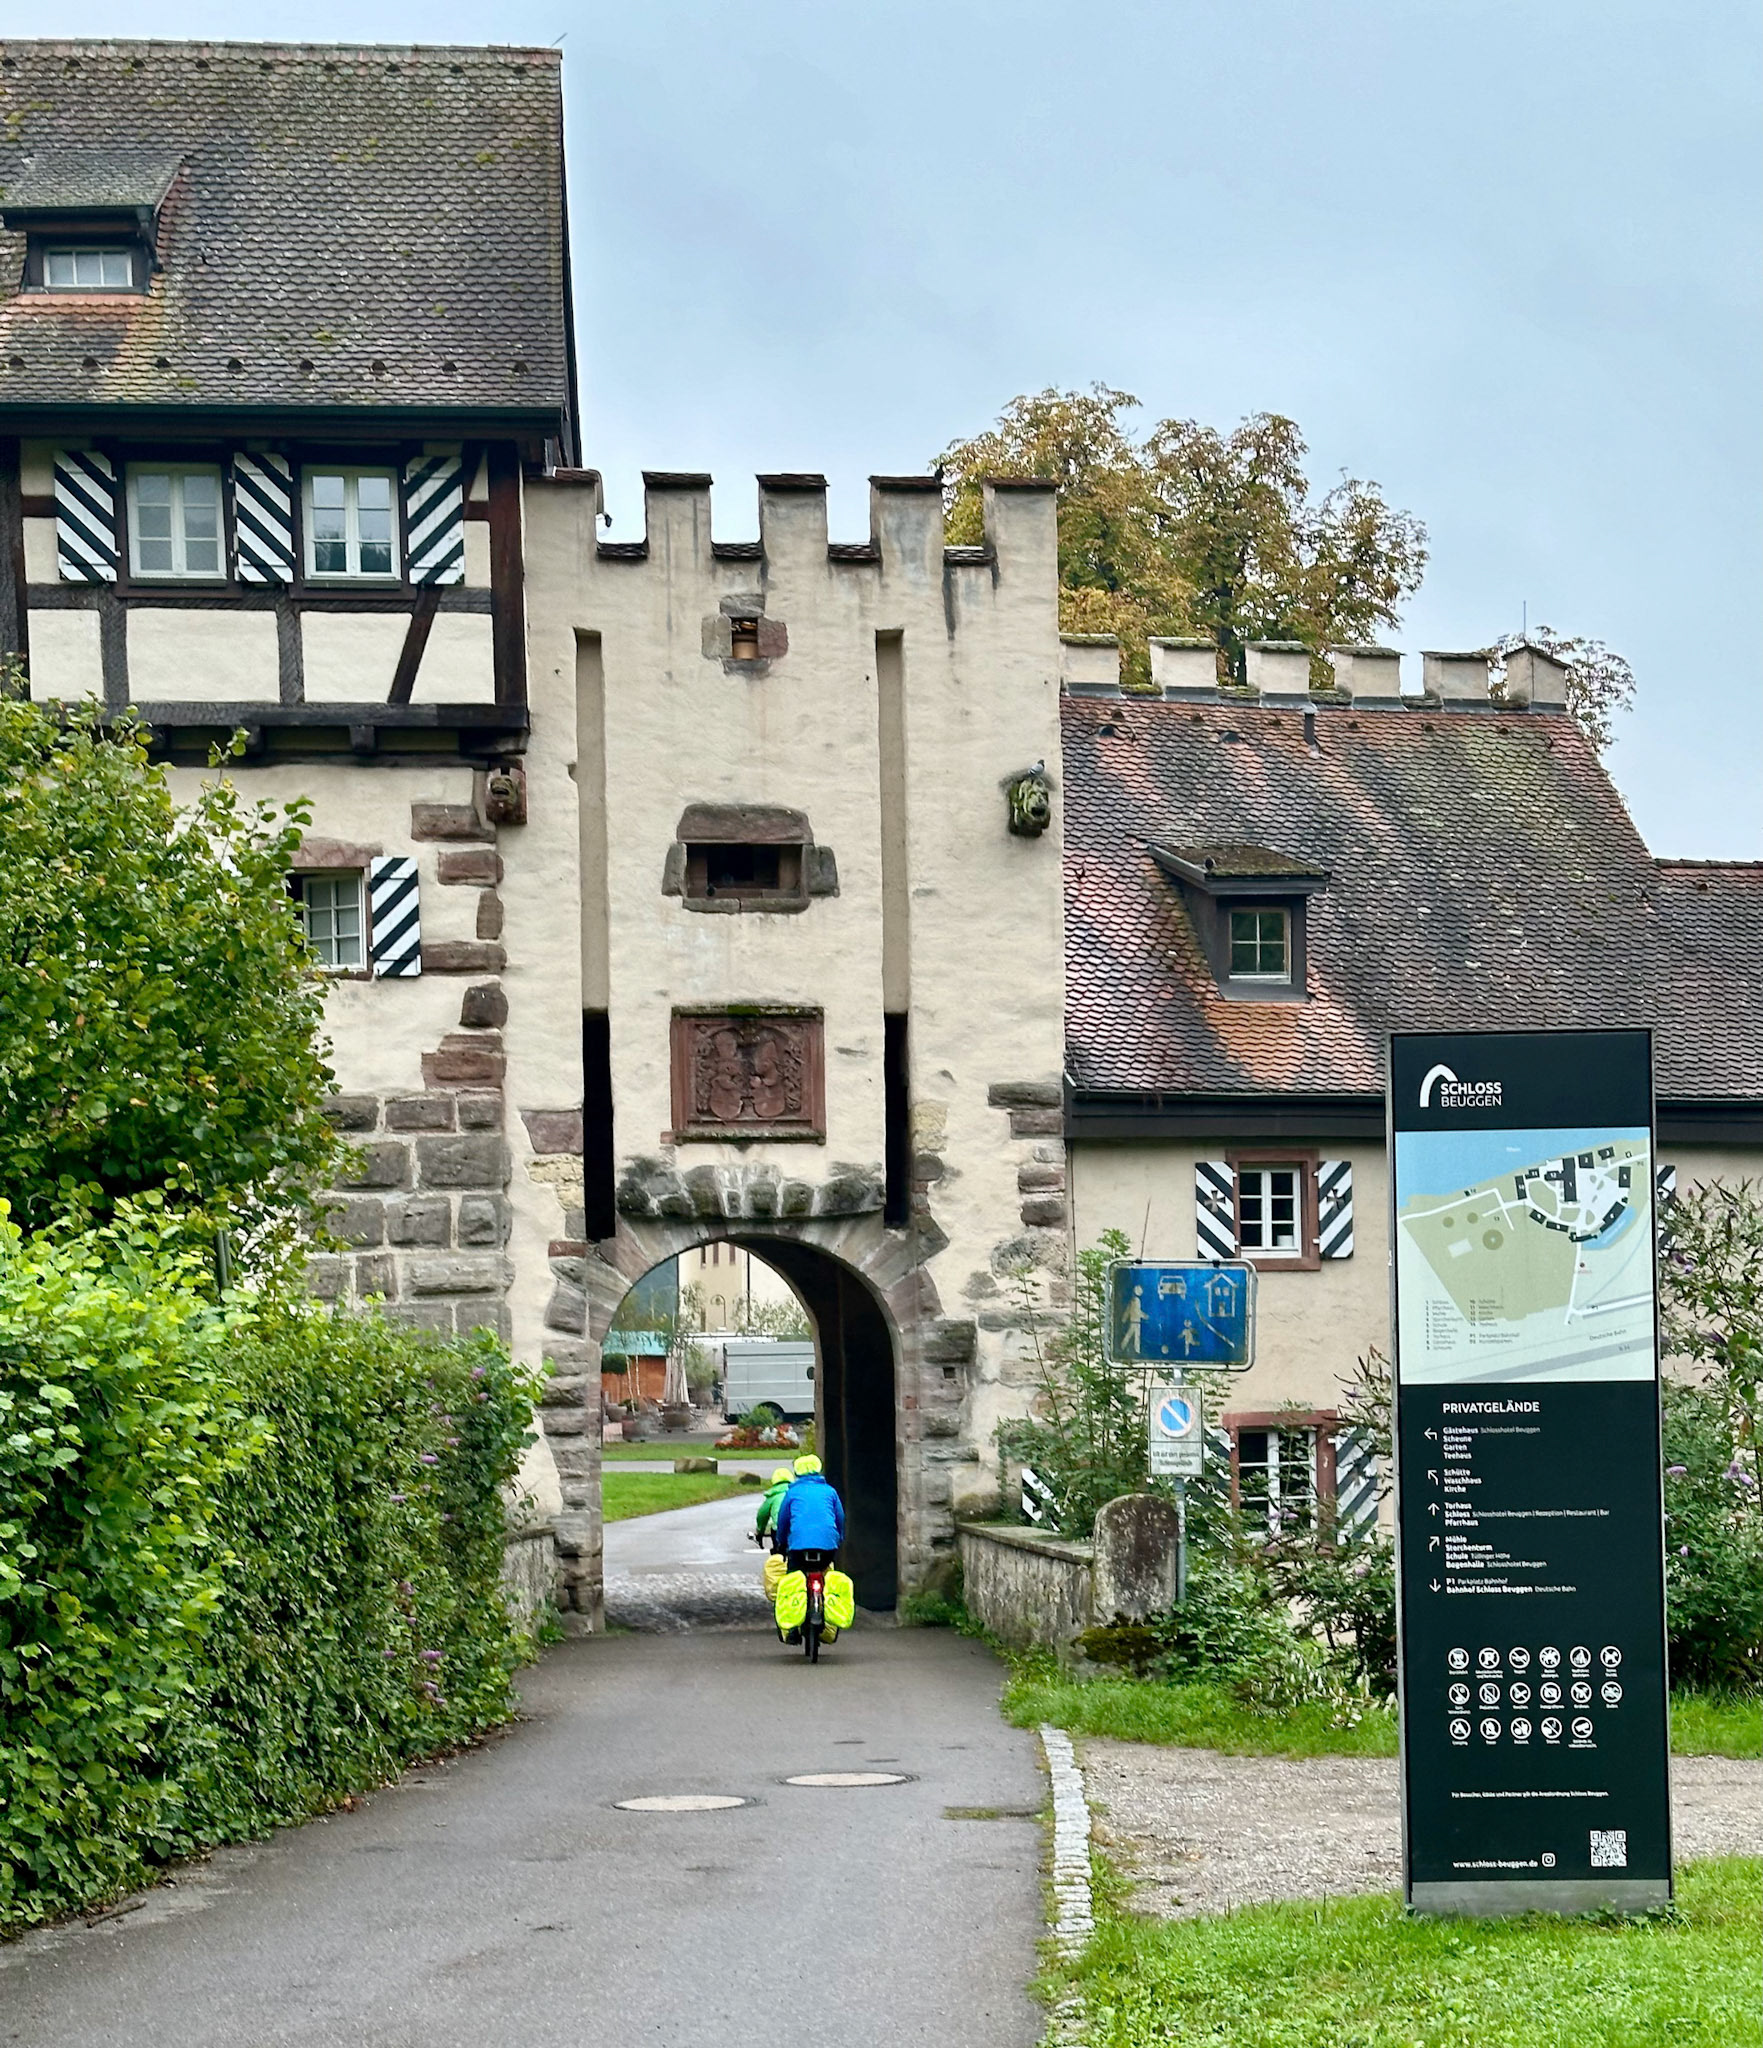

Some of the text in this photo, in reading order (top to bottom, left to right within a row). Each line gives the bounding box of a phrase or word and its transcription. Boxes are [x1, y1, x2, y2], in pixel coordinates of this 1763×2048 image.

[1440, 1082, 1502, 1095] SCHLOSS
[1441, 1095, 1502, 1107] BEUGGEN
[1442, 1399, 1540, 1414] PRIVATGELÄNDE
[1442, 1426, 1479, 1434] Gästehaus
[1443, 1443, 1468, 1451] Garten
[1444, 1485, 1467, 1493] Kirche
[1444, 1502, 1472, 1510] Torhaus
[1444, 1510, 1471, 1518] Schloss
[1445, 1543, 1493, 1551] Storchenturm
[1445, 1552, 1469, 1560] Schule
[1446, 1585, 1476, 1593] Bahnhof
[1476, 1585, 1502, 1593] Schloss
[1502, 1585, 1533, 1594] Beuggen
[1452, 1859, 1539, 1869] www.schloss-beuggen.de
